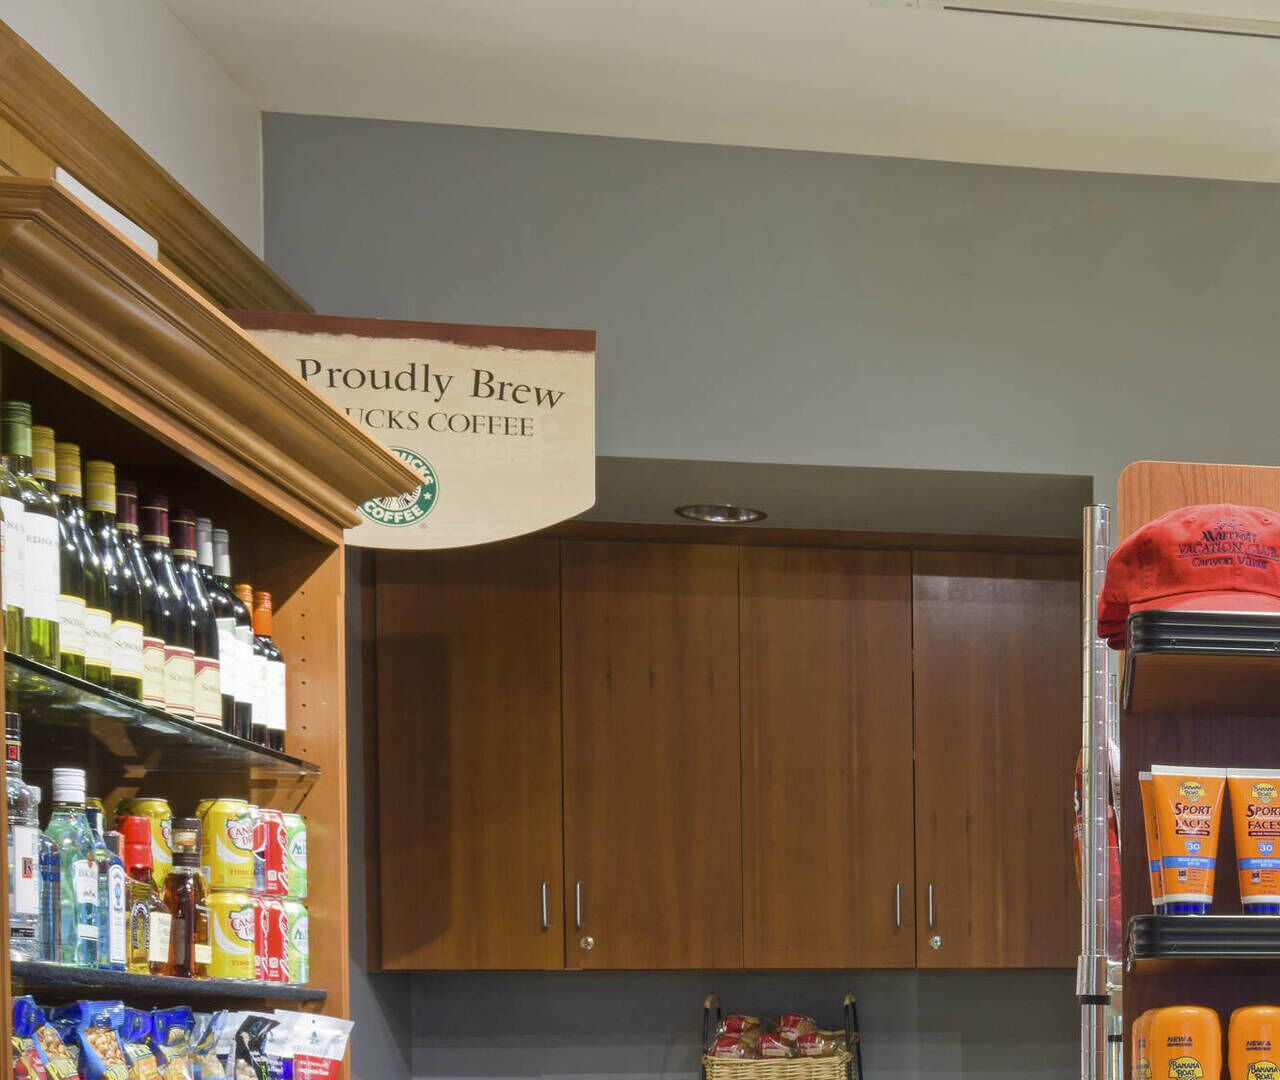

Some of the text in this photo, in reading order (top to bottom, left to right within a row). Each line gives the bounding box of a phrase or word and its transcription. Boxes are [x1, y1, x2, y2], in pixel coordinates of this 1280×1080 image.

[296, 358, 566, 410] Proudly Brew
[344, 407, 534, 437] UCKS COFFEE
[363, 501, 424, 524] COFFEE
[1200, 530, 1257, 543] Marriott
[1178, 541, 1280, 561] VACATION CLUB
[1191, 556, 1235, 569] Canyon
[1174, 802, 1212, 816] SPORT
